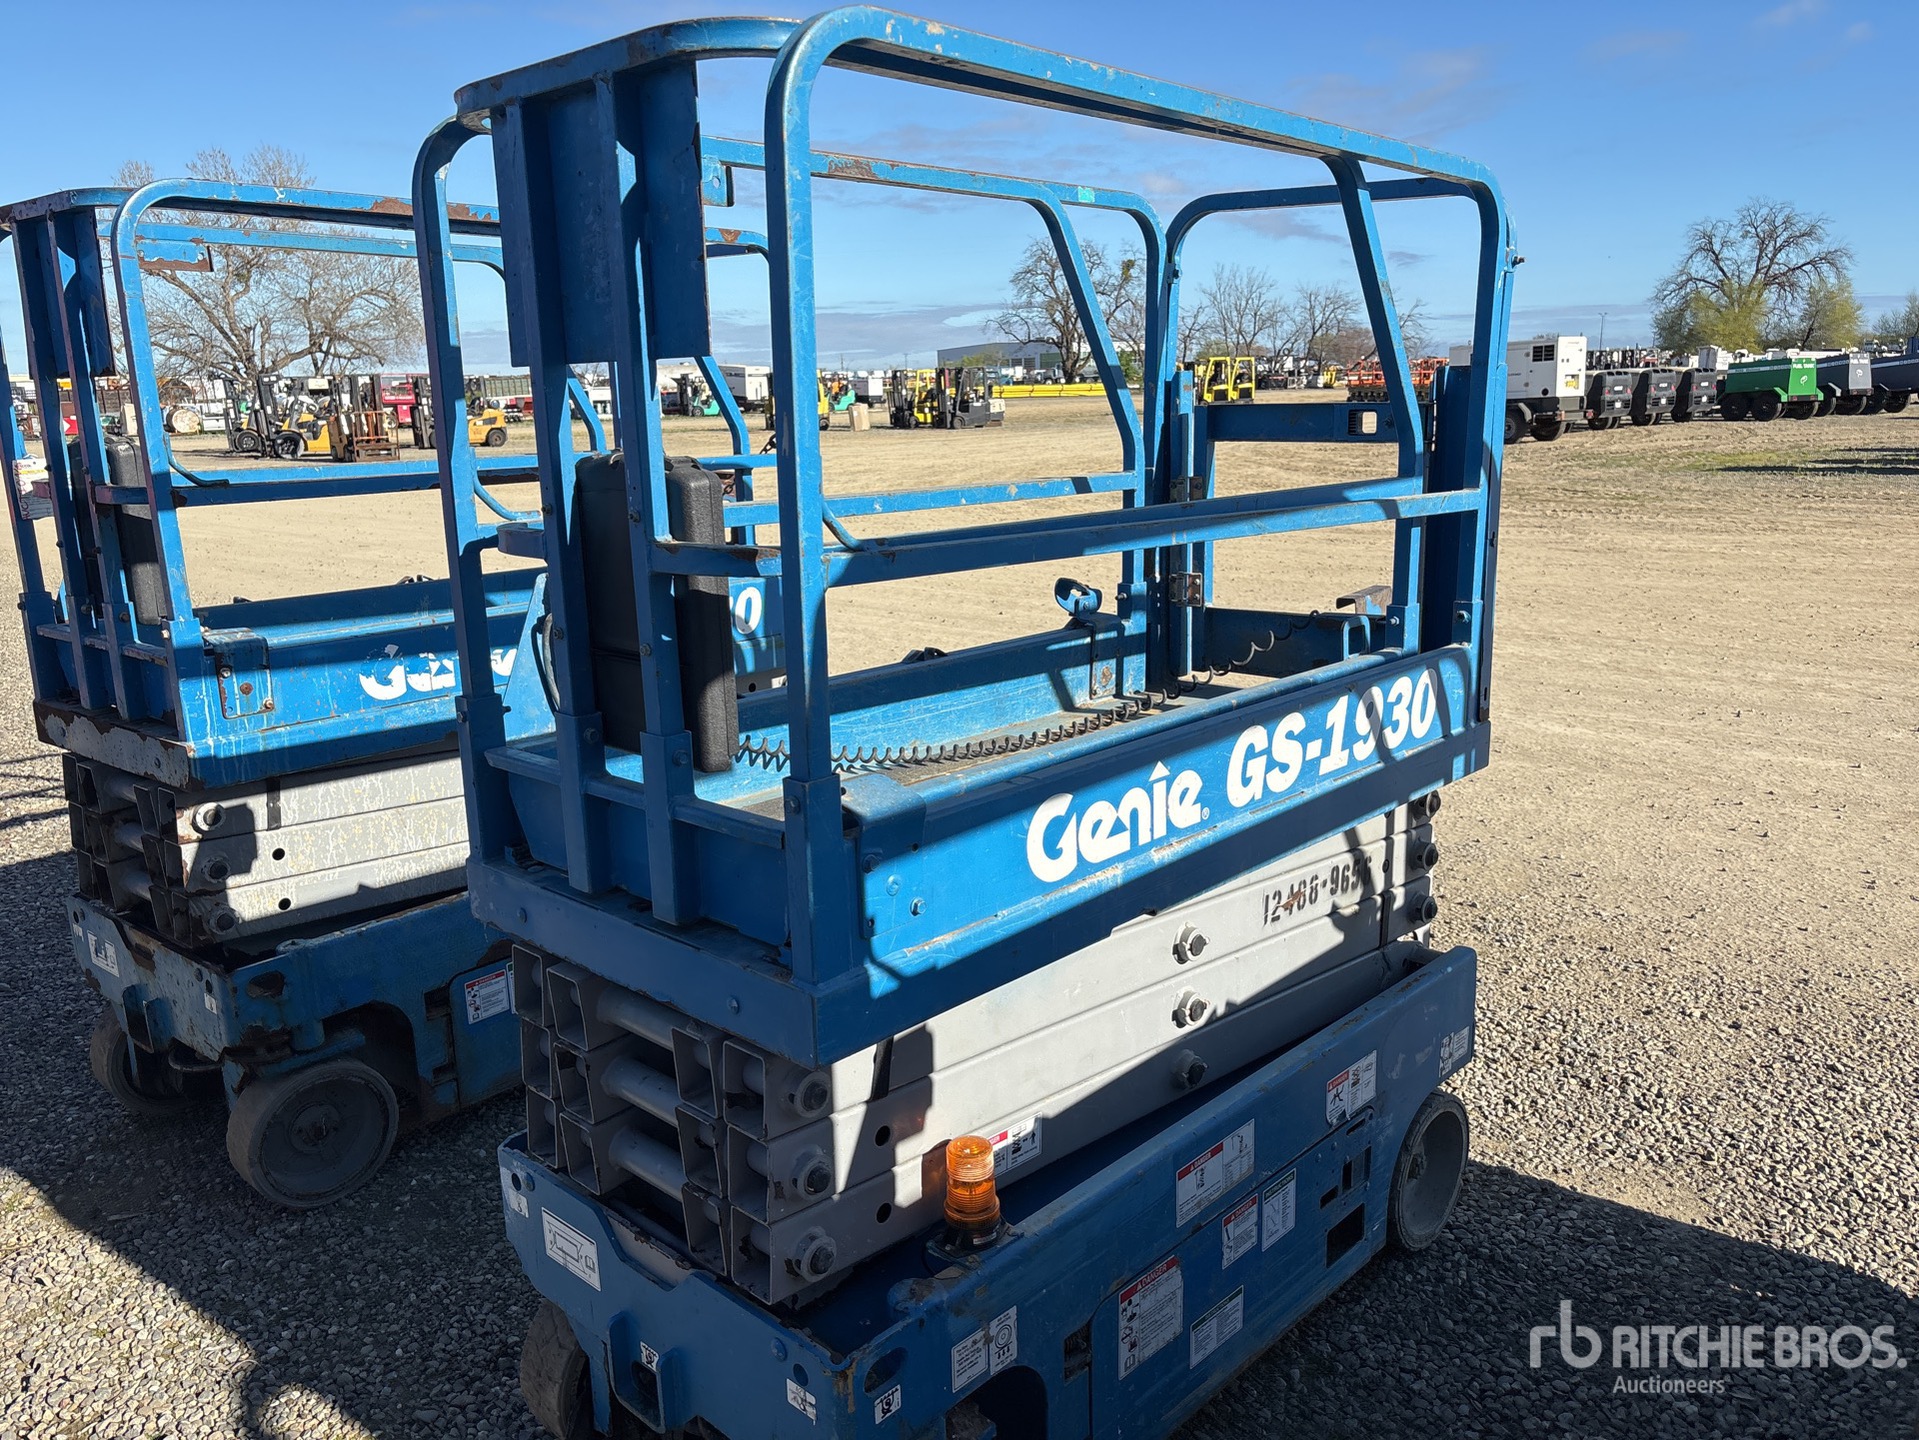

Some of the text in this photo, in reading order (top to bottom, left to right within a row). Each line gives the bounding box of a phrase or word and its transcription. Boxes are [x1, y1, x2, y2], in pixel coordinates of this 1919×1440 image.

[1226, 668, 1438, 807] GS-1930
[1026, 761, 1203, 883] Genie
[1141, 1264, 1167, 1287] DANGER
